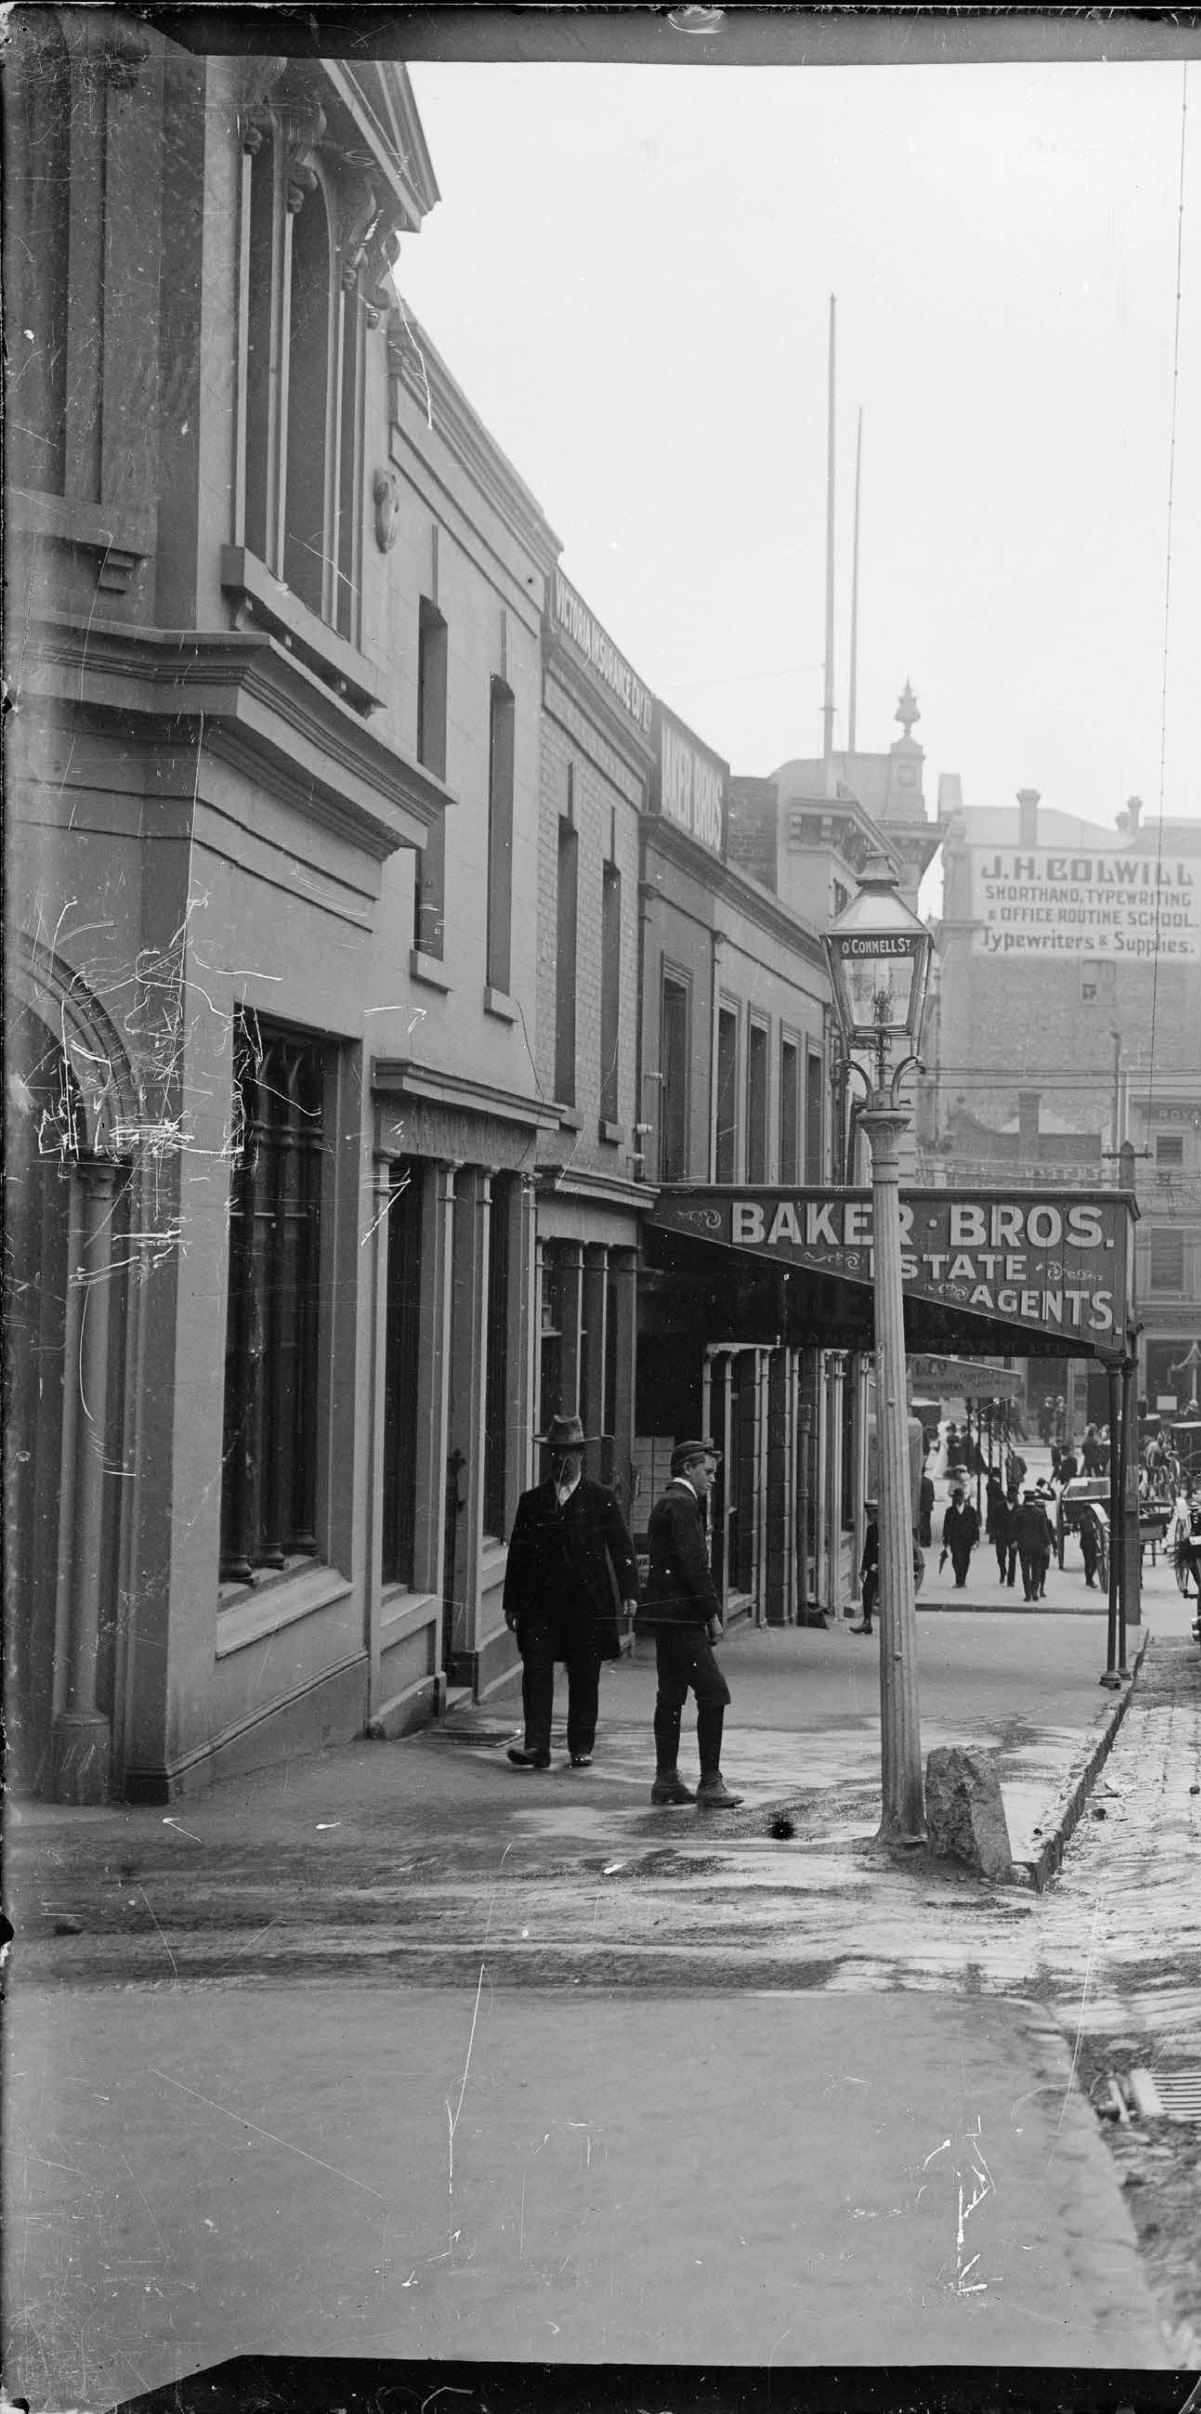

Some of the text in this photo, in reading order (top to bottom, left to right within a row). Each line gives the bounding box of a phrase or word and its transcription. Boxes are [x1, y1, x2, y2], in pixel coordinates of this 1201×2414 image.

[1088, 888, 1191, 907] TYPEWRITING
[1001, 907, 1053, 923] OFFICE
[1058, 909, 1121, 925] ROUTINE
[982, 927, 1095, 952] Typewriters
[1099, 936, 1108, 946] &
[950, 1204, 1115, 1249] BROS.
[869, 1249, 1027, 1281] STATE
[969, 1284, 1123, 1336] AGENTS.
